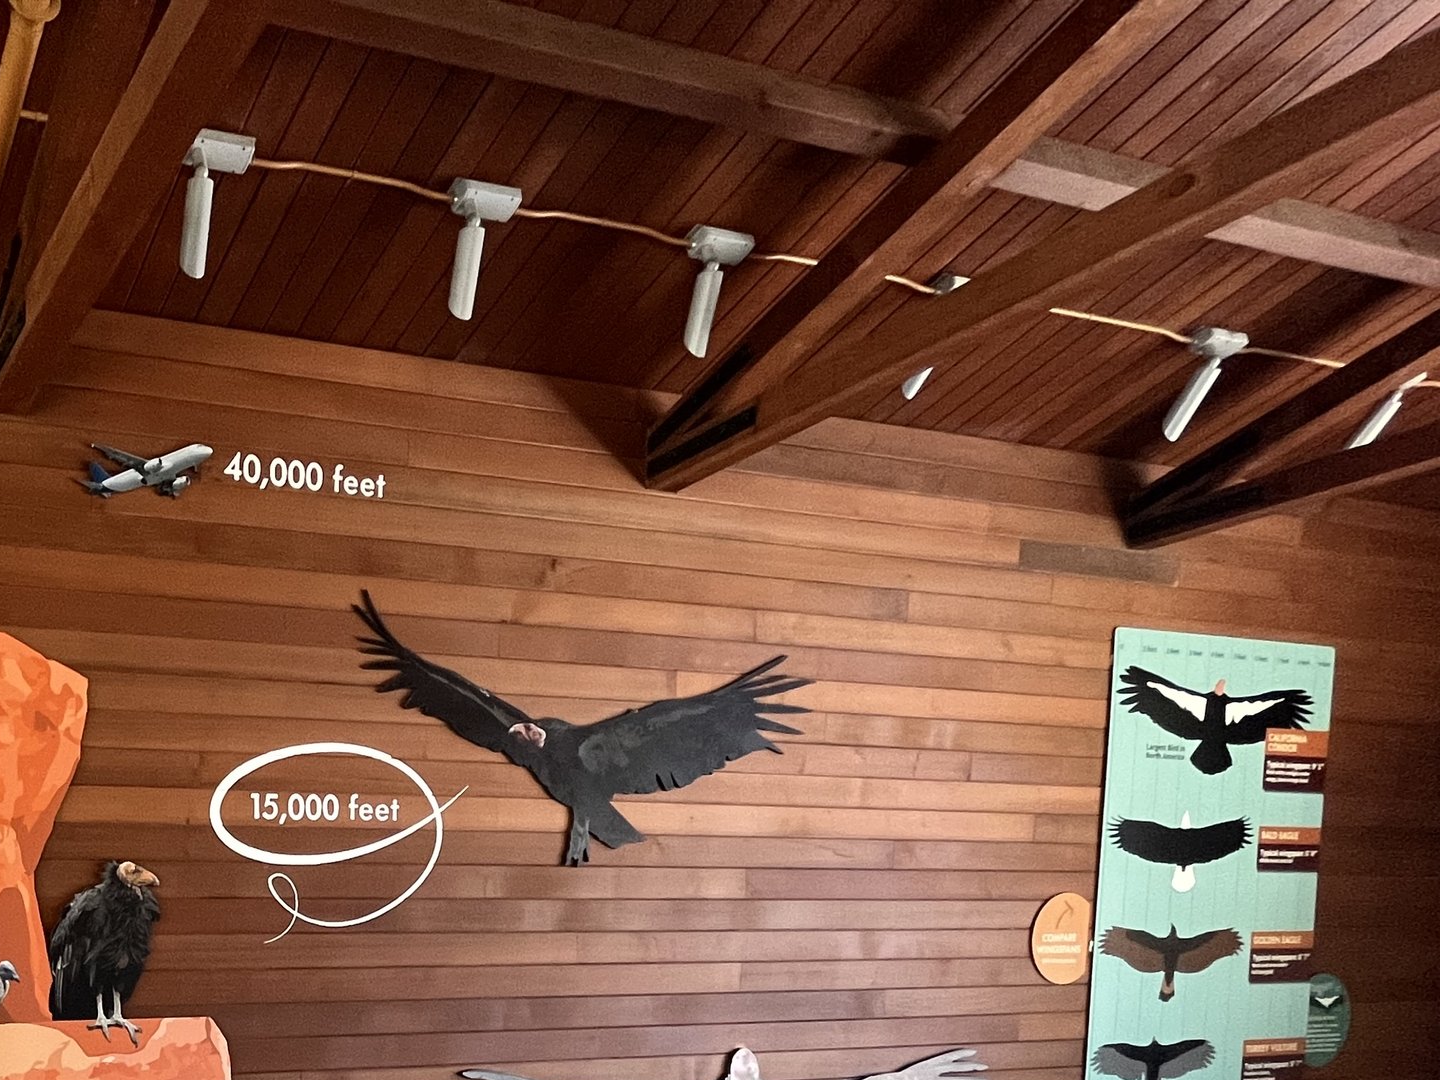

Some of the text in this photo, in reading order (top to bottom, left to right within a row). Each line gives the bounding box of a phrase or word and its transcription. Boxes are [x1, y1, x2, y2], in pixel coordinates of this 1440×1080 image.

[223, 451, 386, 498] 40,000 feet
[250, 792, 400, 825] 15,000 feet
